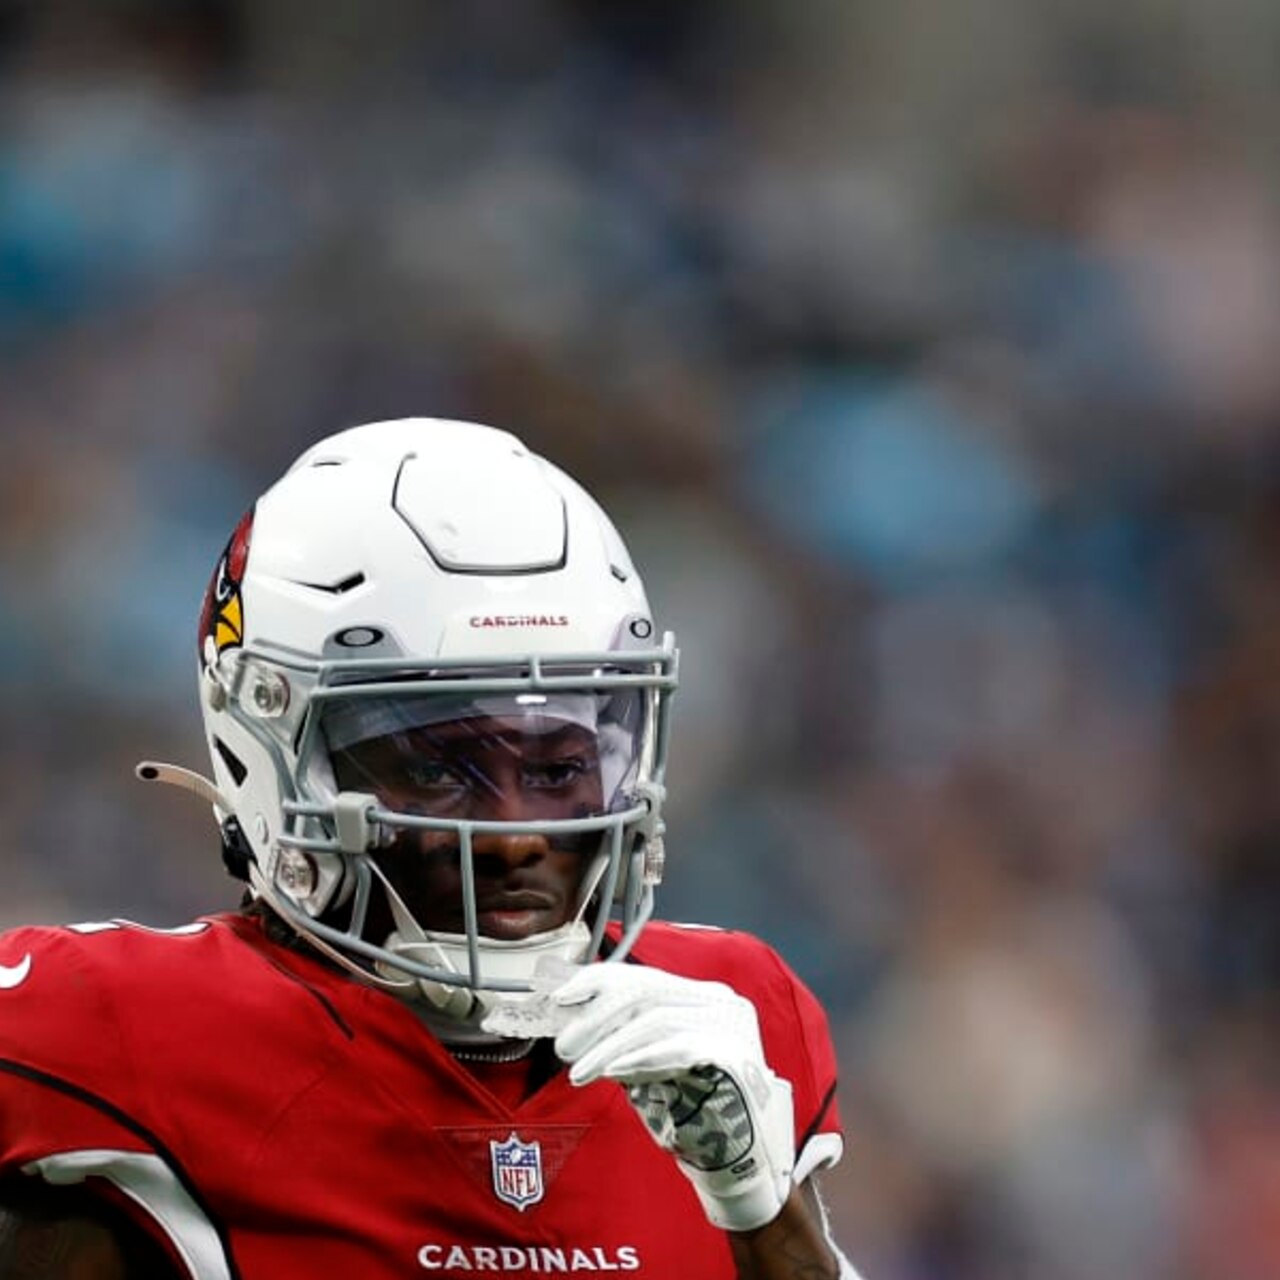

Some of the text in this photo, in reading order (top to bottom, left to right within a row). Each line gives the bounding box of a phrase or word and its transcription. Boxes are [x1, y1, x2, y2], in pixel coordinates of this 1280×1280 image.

[469, 615, 569, 628] CARDINALS
[500, 1168, 536, 1195] NFL
[417, 1244, 640, 1273] CARDINALS
